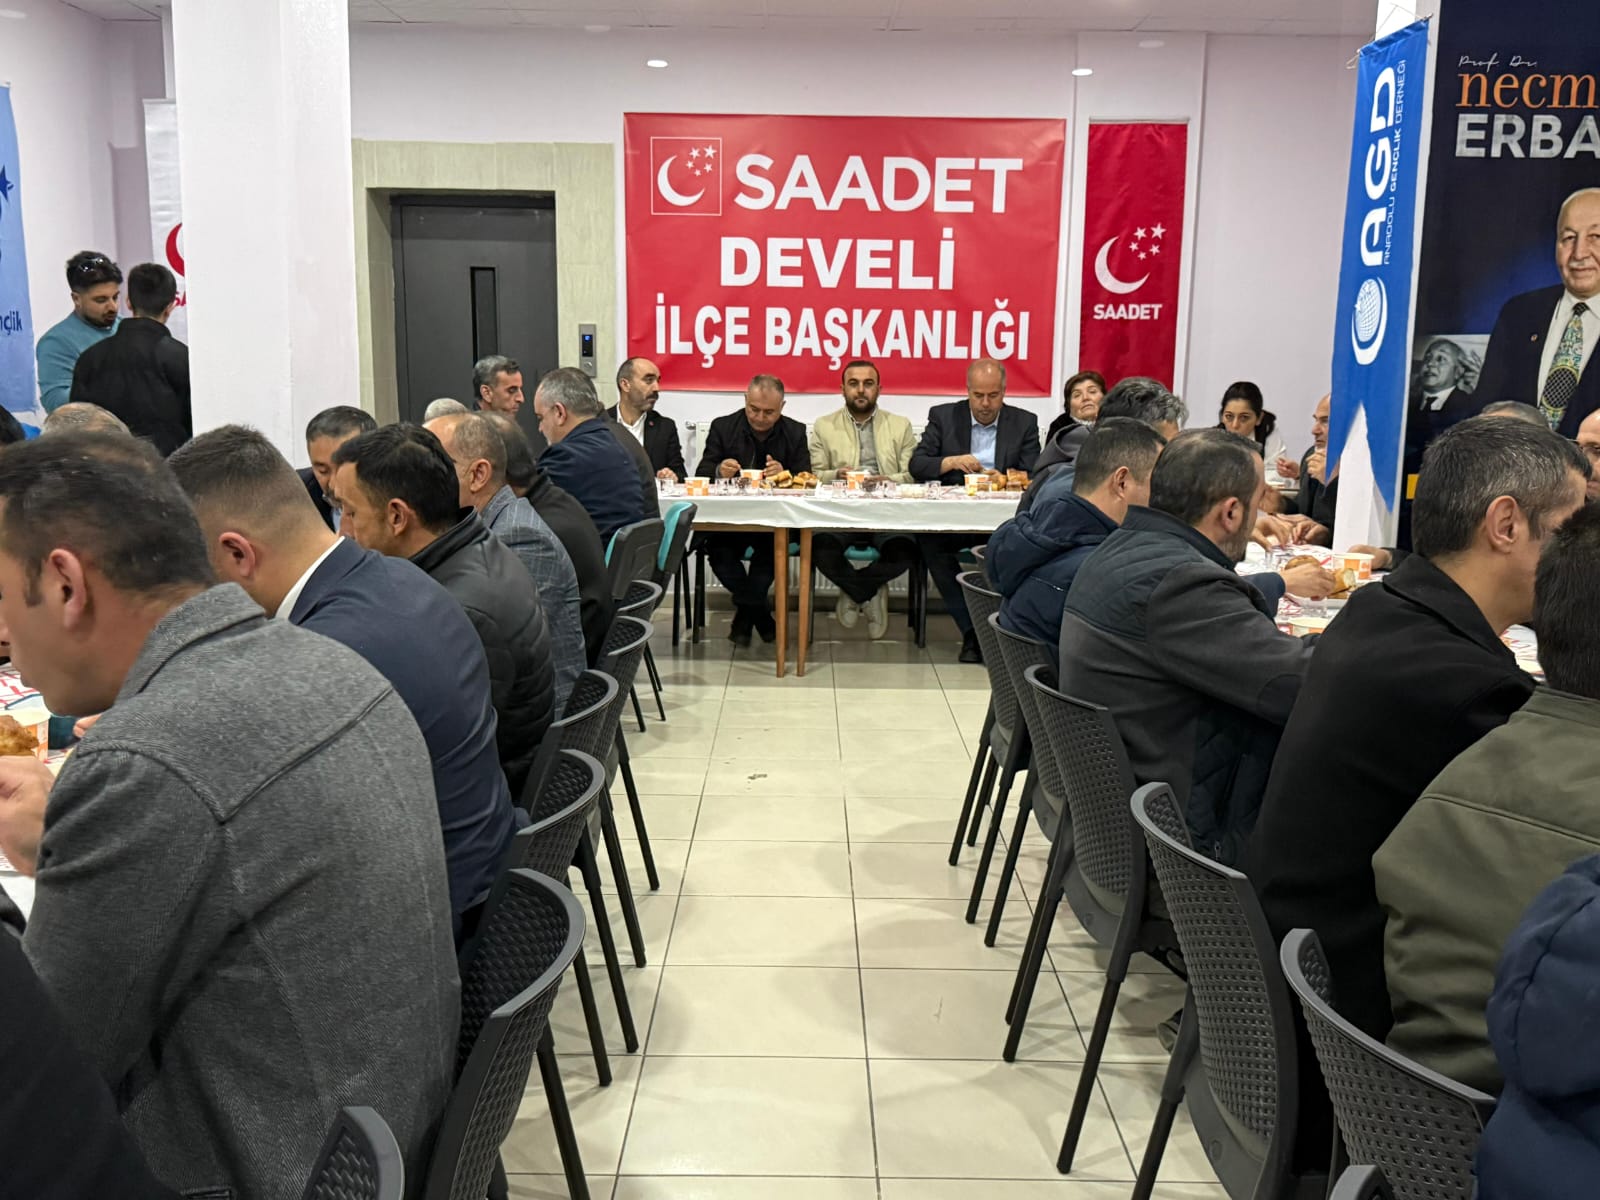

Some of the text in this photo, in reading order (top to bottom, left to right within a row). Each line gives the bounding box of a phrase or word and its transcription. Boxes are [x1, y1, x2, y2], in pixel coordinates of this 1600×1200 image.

[1455, 73, 1600, 109] necm
[1361, 67, 1395, 266] AGD
[1455, 113, 1600, 159] ERBA
[734, 153, 1024, 214] SAADET
[721, 227, 955, 290] DEVELİ
[1384, 197, 1396, 265] ANADOLU
[656, 293, 1030, 371] İLÇE BAŞKANLIĞI
[1093, 303, 1163, 320] SAADET
